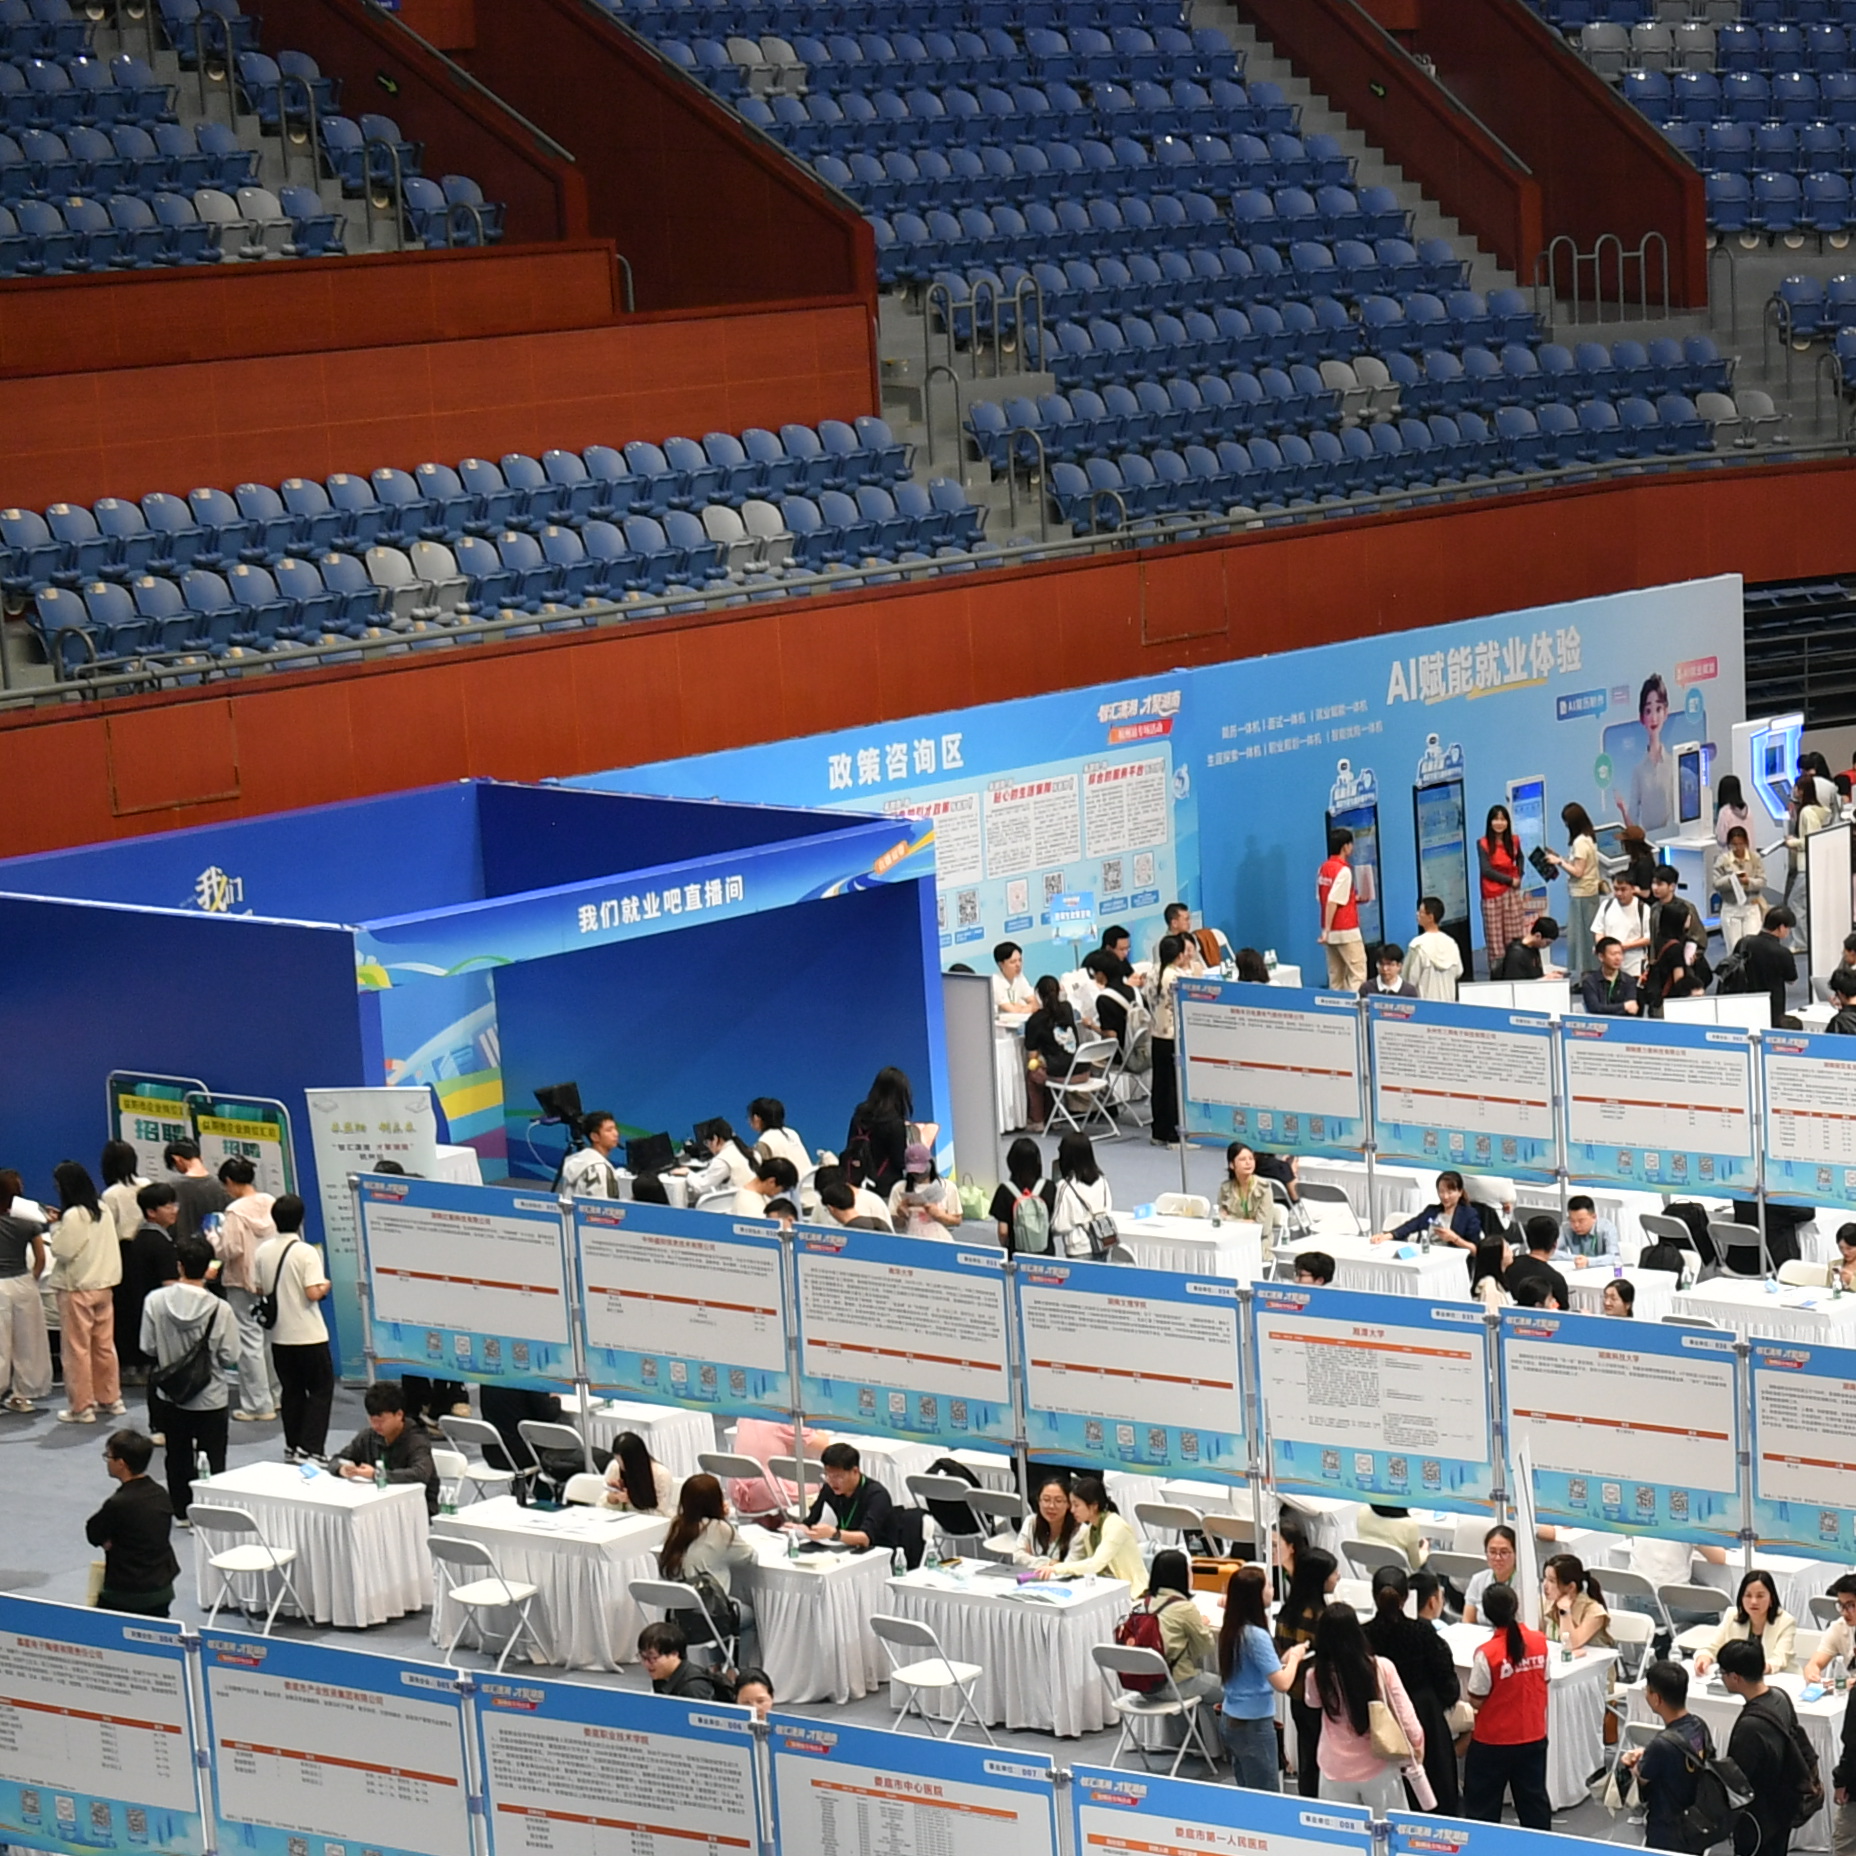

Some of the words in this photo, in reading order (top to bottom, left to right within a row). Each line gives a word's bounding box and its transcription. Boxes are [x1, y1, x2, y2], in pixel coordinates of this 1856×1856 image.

[1387, 625, 1583, 705] AI赋能就业体验
[828, 733, 964, 790] 政策咨询区
[577, 874, 745, 934] 我们就业吧直播间
[135, 1118, 186, 1142] 招聘
[874, 1776, 943, 1797] 娄底市中心医院
[1175, 1827, 1268, 1851] 娄底市第一人民医院
